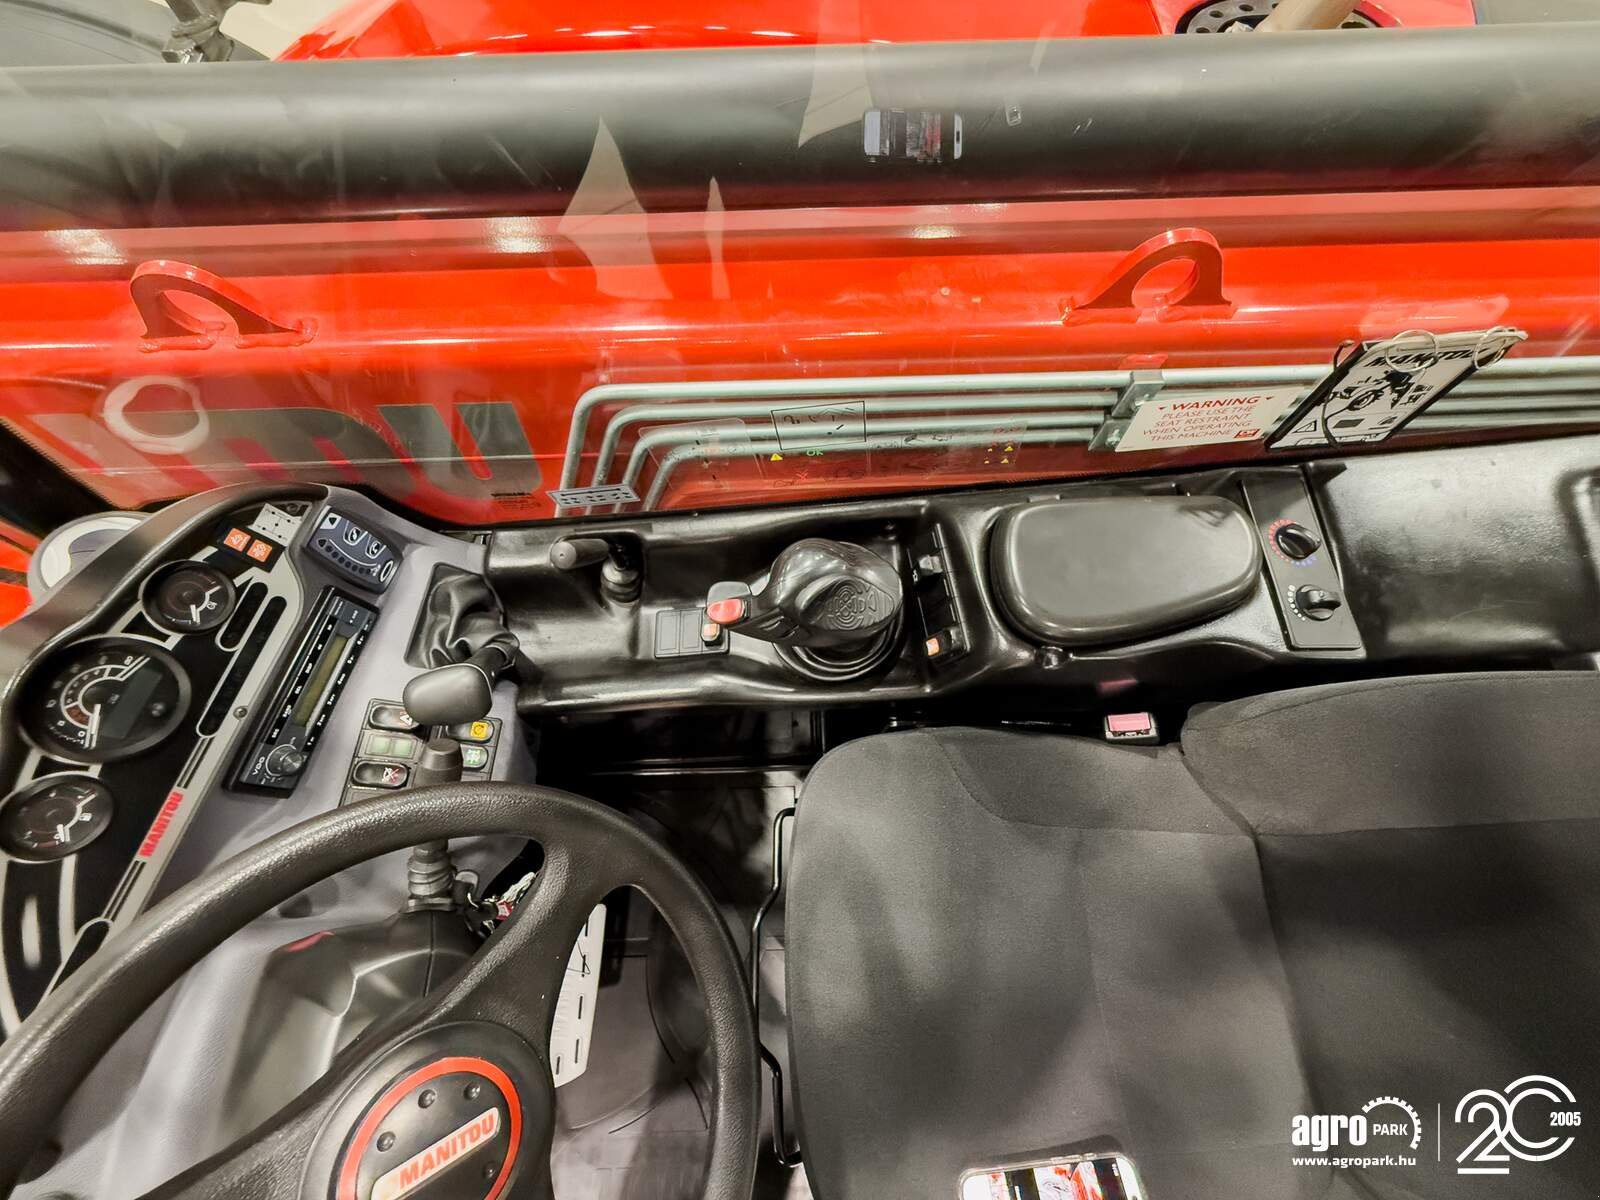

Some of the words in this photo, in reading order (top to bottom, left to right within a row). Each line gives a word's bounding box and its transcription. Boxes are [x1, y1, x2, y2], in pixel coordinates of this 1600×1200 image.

[1171, 395, 1261, 411] WARNING
[1154, 419, 1181, 428] SEAT
[1184, 413, 1252, 425] RESTRAINT
[1162, 410, 1202, 419] PLEASE
[1206, 408, 1230, 416] USE
[1143, 426, 1179, 436] WHEN
[1184, 420, 1252, 432] OPERATING
[1151, 433, 1175, 441] THIS
[1177, 430, 1231, 439] MACHINE
[252, 756, 266, 776] VDO
[138, 789, 184, 858] MANITOU
[400, 1113, 495, 1190] MANITOU
